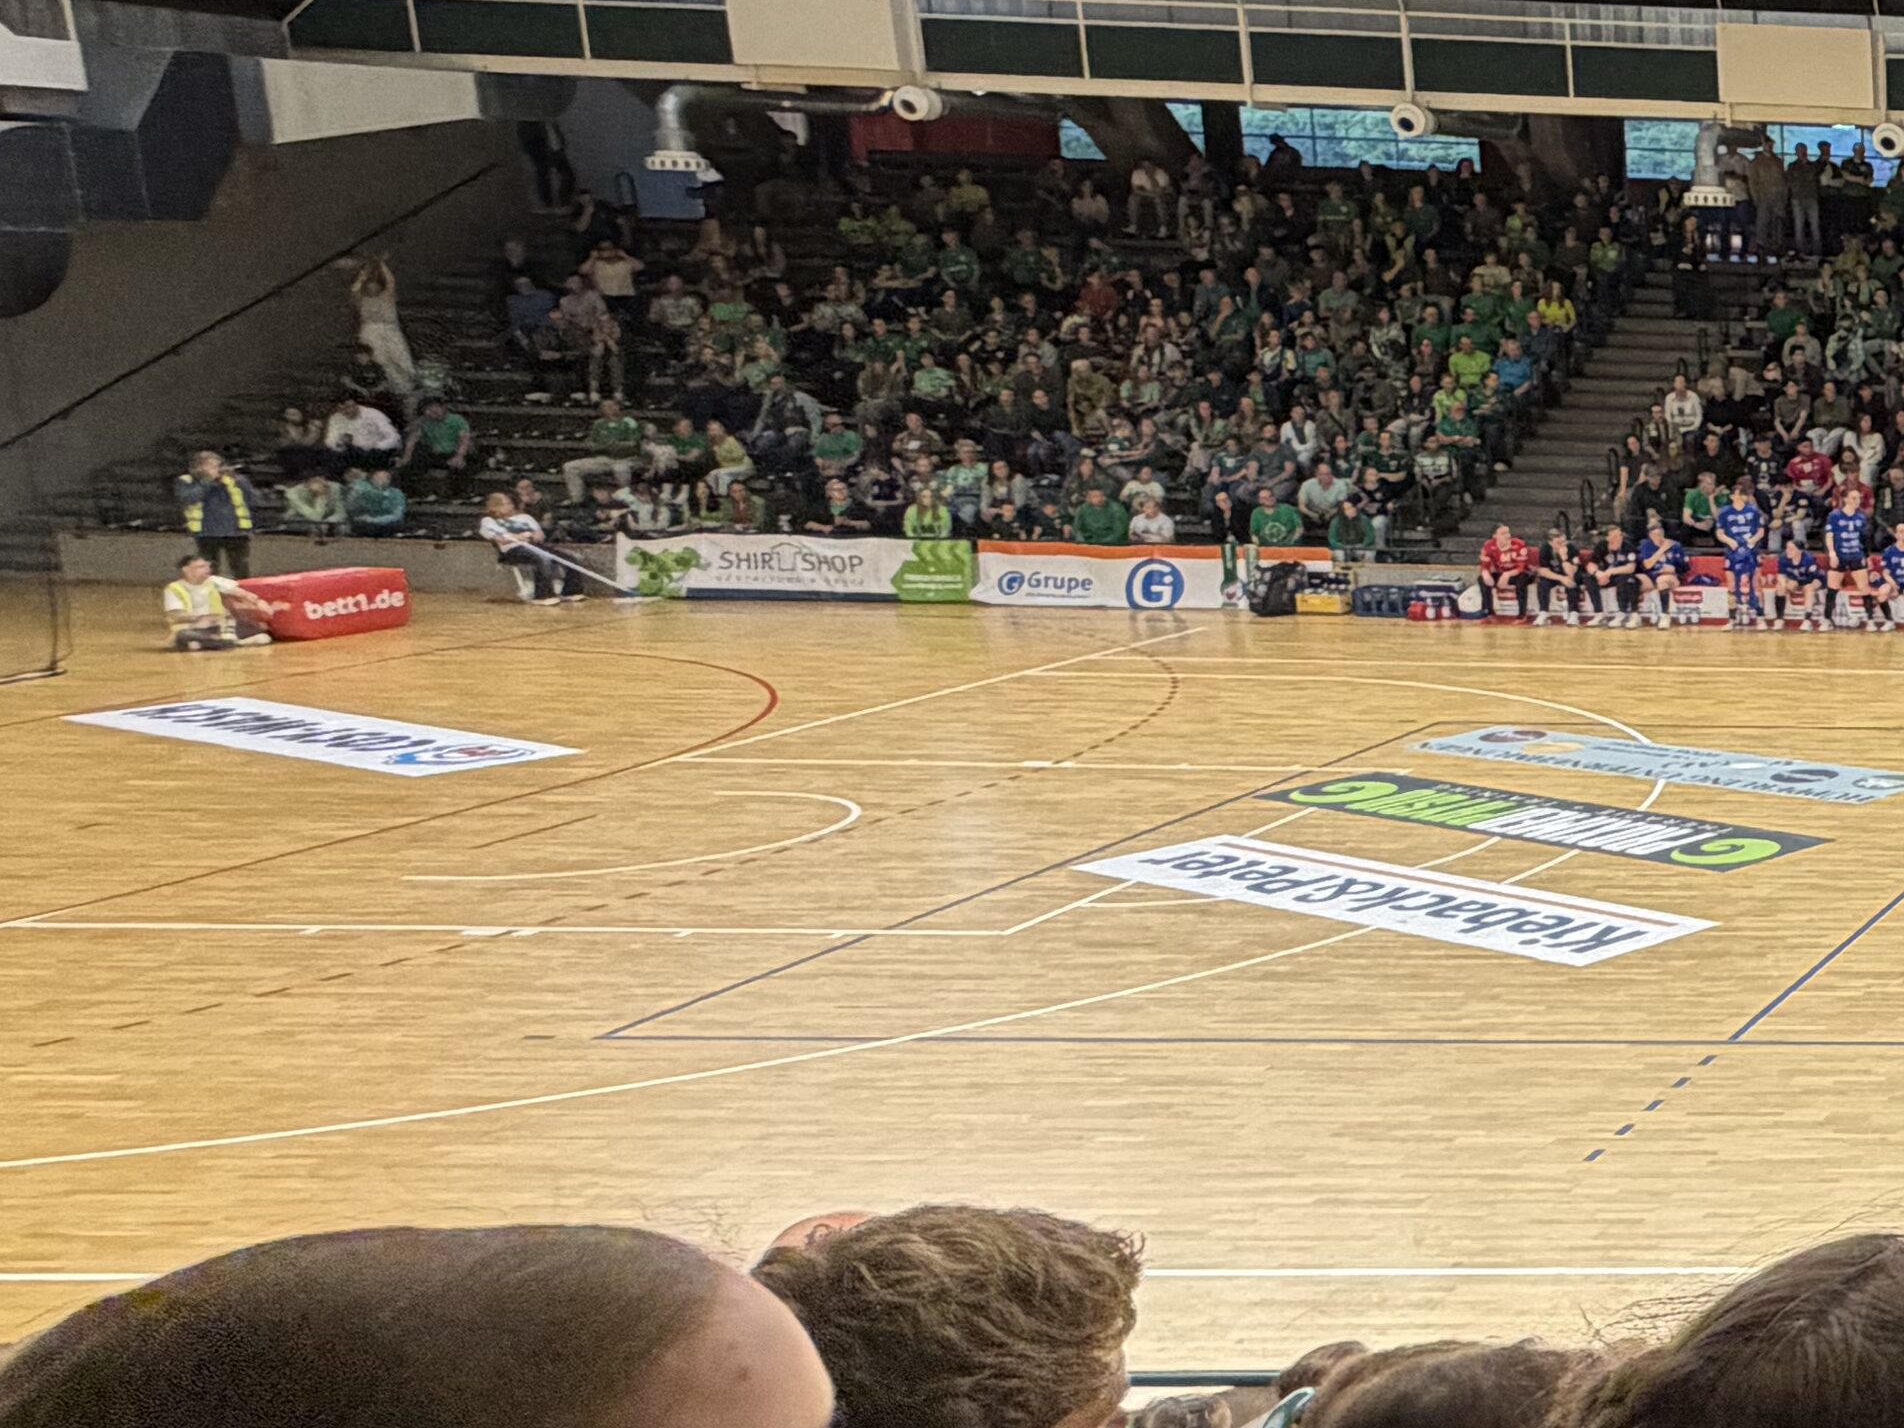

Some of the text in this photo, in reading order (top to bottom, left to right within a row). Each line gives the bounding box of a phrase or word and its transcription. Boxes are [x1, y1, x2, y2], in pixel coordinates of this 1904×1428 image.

[800, 553, 864, 573] SHOP
[1027, 571, 1093, 591] Grupe
[1137, 849, 1649, 955] Kieback&Peter
